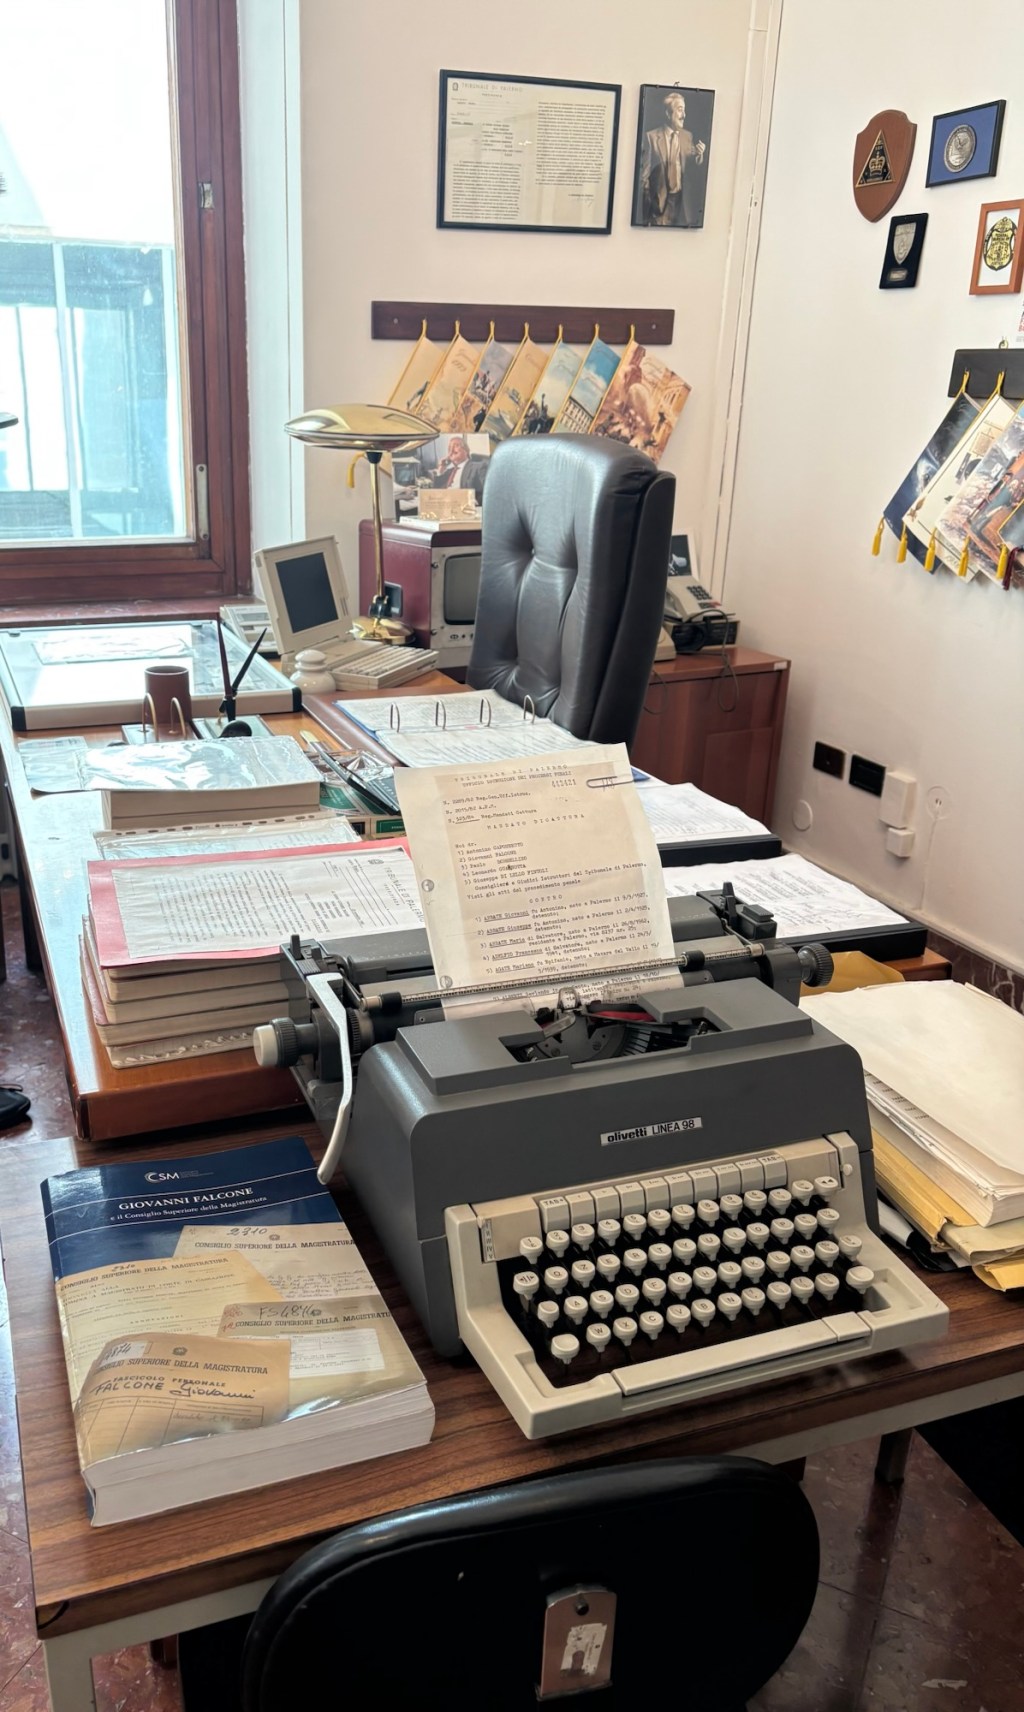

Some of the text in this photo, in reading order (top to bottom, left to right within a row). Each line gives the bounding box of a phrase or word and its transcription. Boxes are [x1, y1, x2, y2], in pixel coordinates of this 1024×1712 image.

[607, 1119, 695, 1142] olivetti LINEA 98
[145, 1171, 180, 1184] CSM
[118, 1187, 254, 1211] GIOVANNI FALCONE
[125, 1210, 162, 1220] Consiglio
[163, 1207, 199, 1217] Superiore
[200, 1203, 218, 1212] della
[220, 1196, 268, 1208] Magistratura
[226, 1226, 268, 1237] 2310
[194, 1241, 232, 1249] CONSIGLIO
[234, 1242, 273, 1250] SUPERIORE
[300, 1239, 356, 1248] MAGISTRATURA
[60, 1258, 229, 1291] CONSIGLIO SUPERIORE DELLA MAGISTRATURA
[235, 1320, 272, 1328] CONSIGLIO
[274, 1319, 314, 1327] SUPERIORE
[316, 1317, 339, 1325] DELLA
[127, 1357, 268, 1375] SUPERIORE DELLA MAGISTRATURA
[90, 1380, 256, 1399] FALCONE Giovanni
